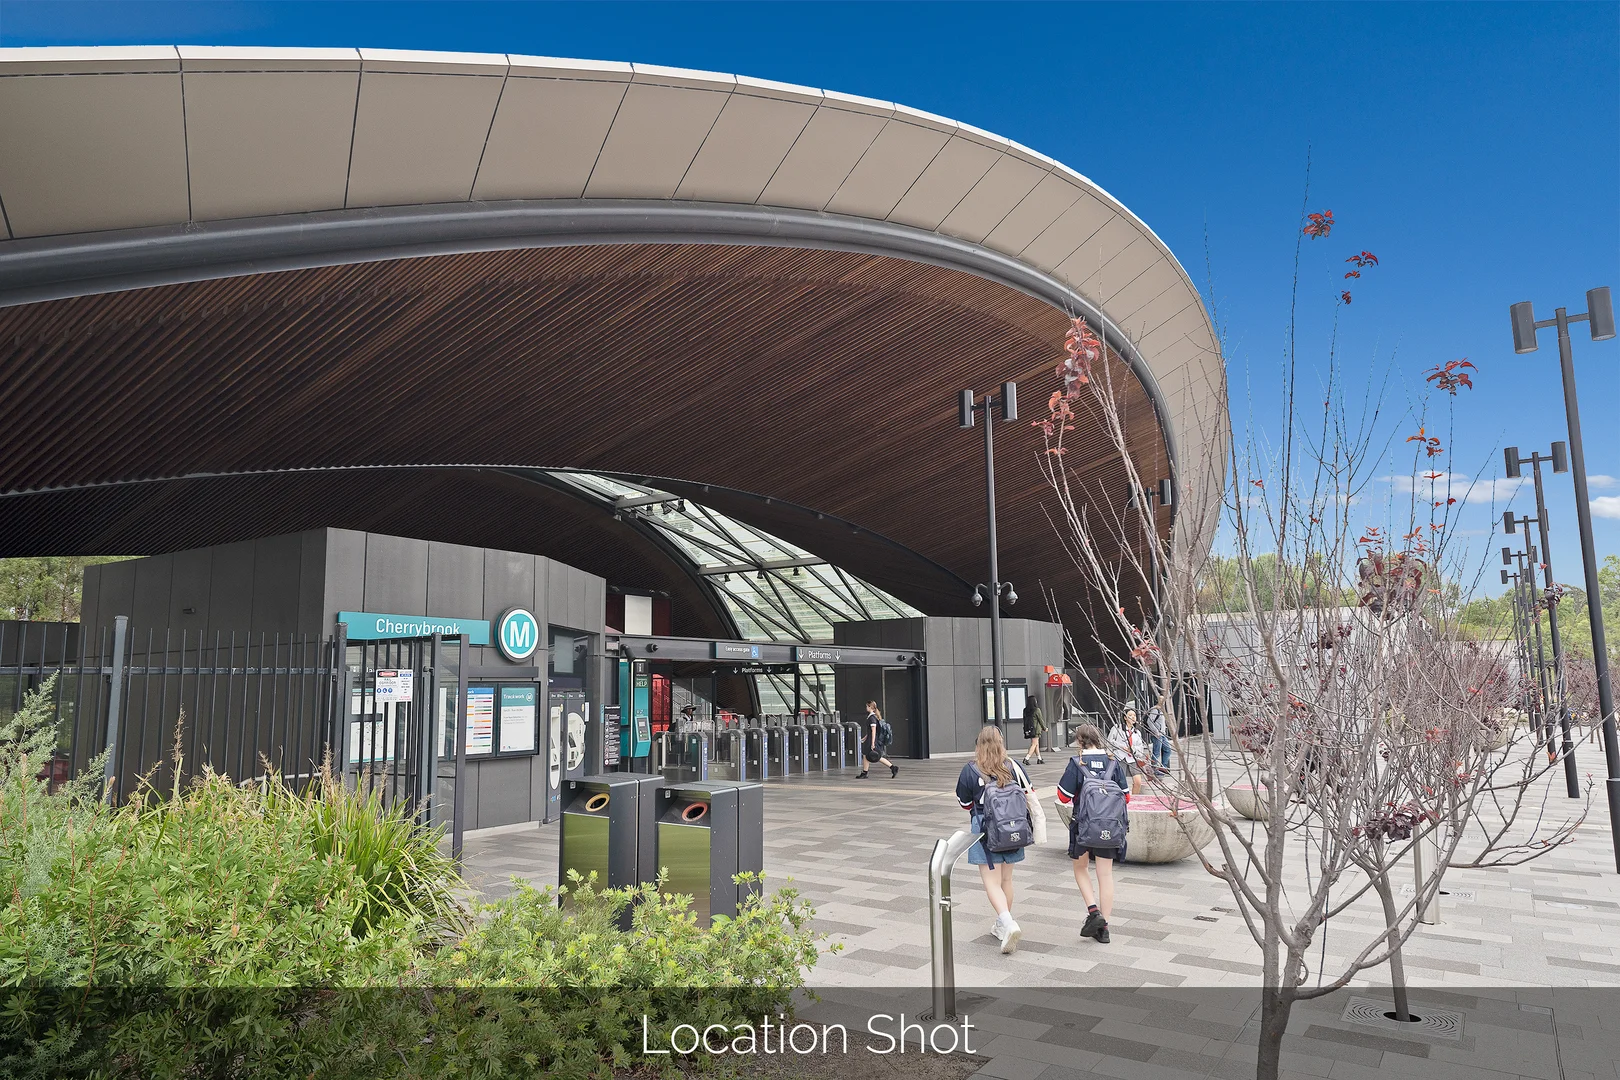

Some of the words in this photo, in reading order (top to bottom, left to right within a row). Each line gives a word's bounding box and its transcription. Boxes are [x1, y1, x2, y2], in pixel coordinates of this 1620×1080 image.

[375, 618, 461, 637] Cherrybrook
[509, 620, 530, 648] M
[808, 651, 832, 660] Platforms
